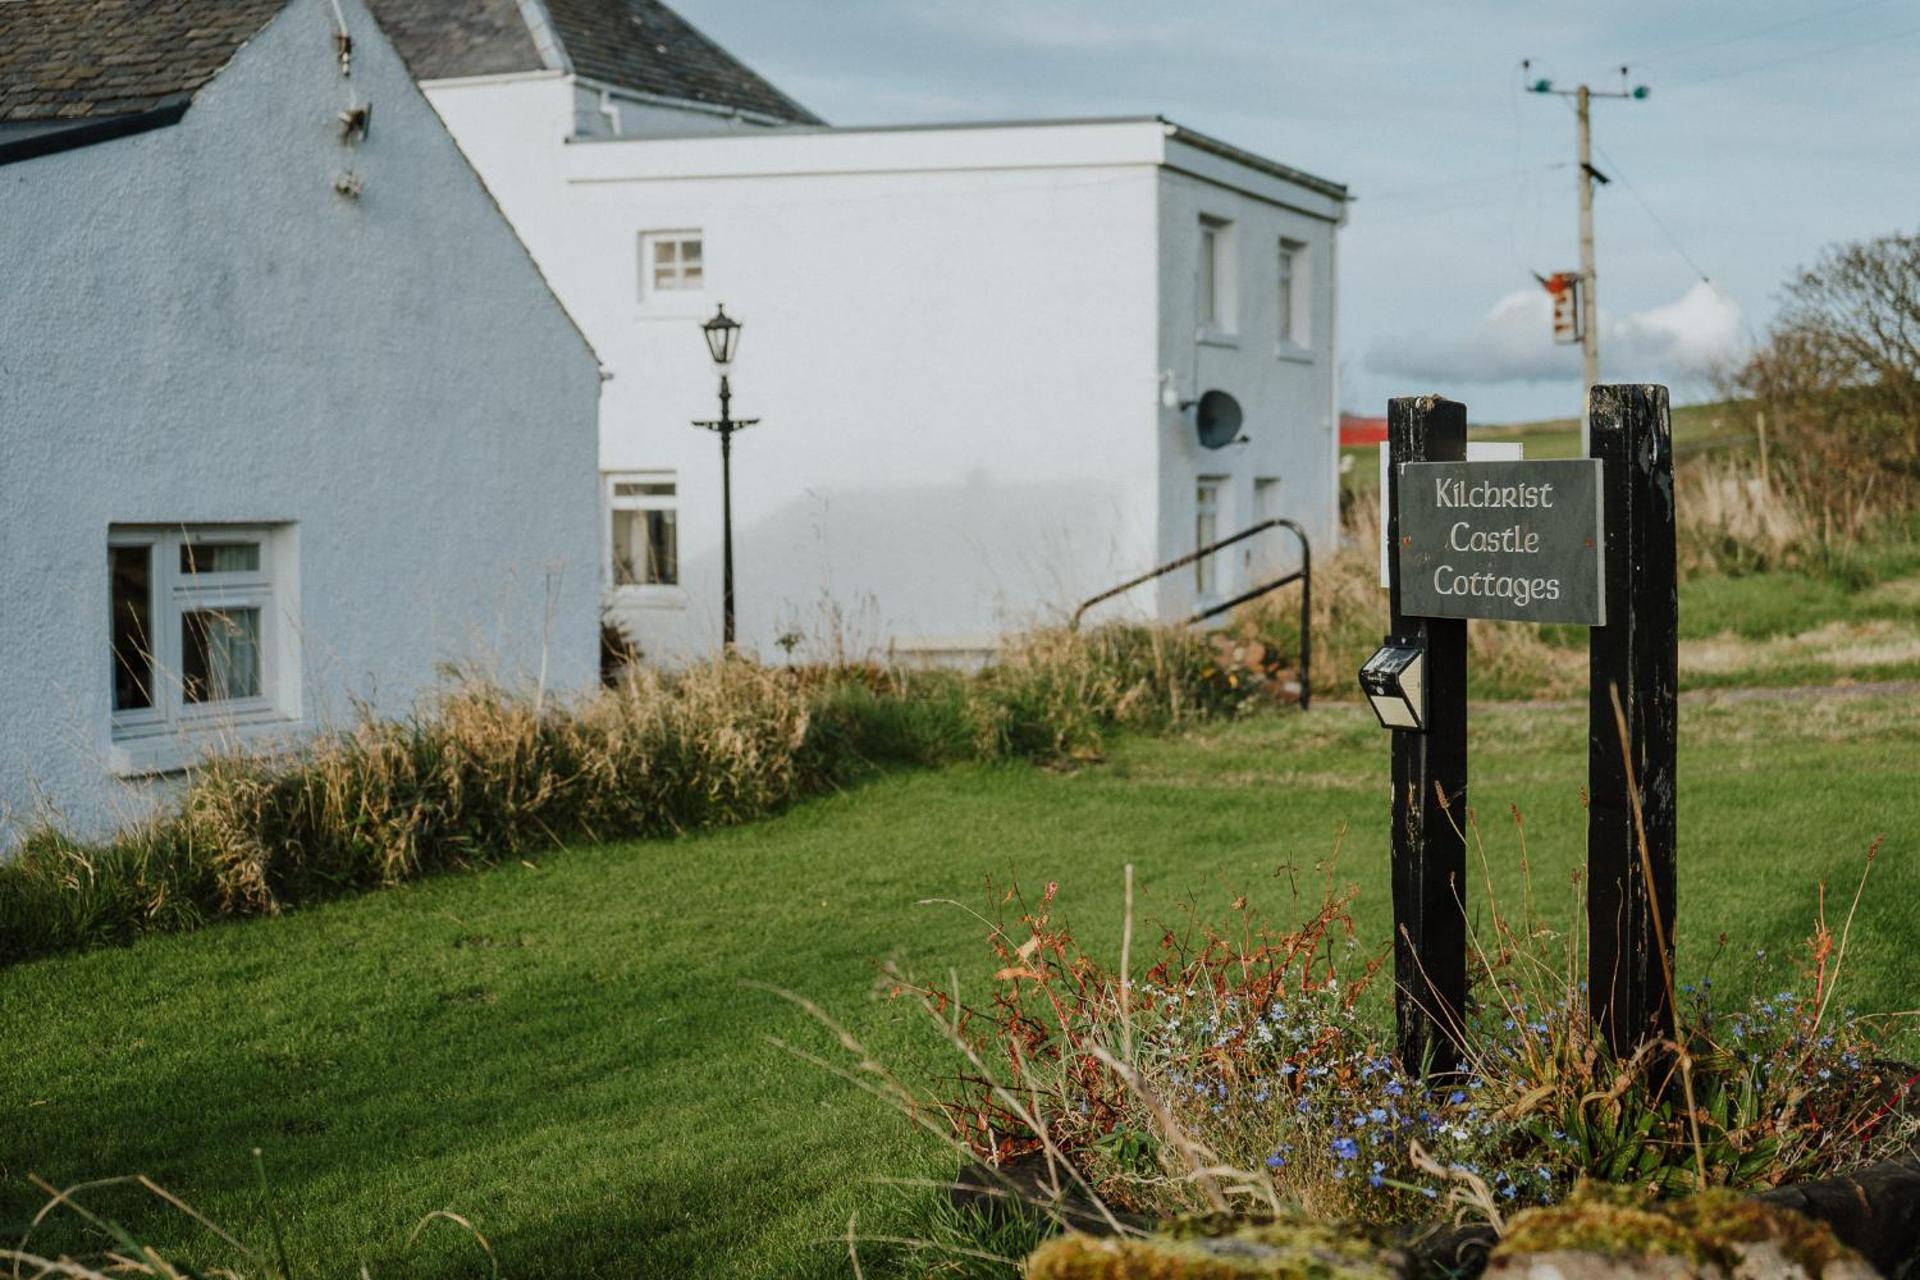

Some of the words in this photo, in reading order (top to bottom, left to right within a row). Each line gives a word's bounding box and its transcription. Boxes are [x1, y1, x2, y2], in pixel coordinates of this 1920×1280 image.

[1434, 477, 1554, 508] Kilchrist
[1450, 521, 1540, 553] Castle
[1433, 565, 1560, 607] Cottages
